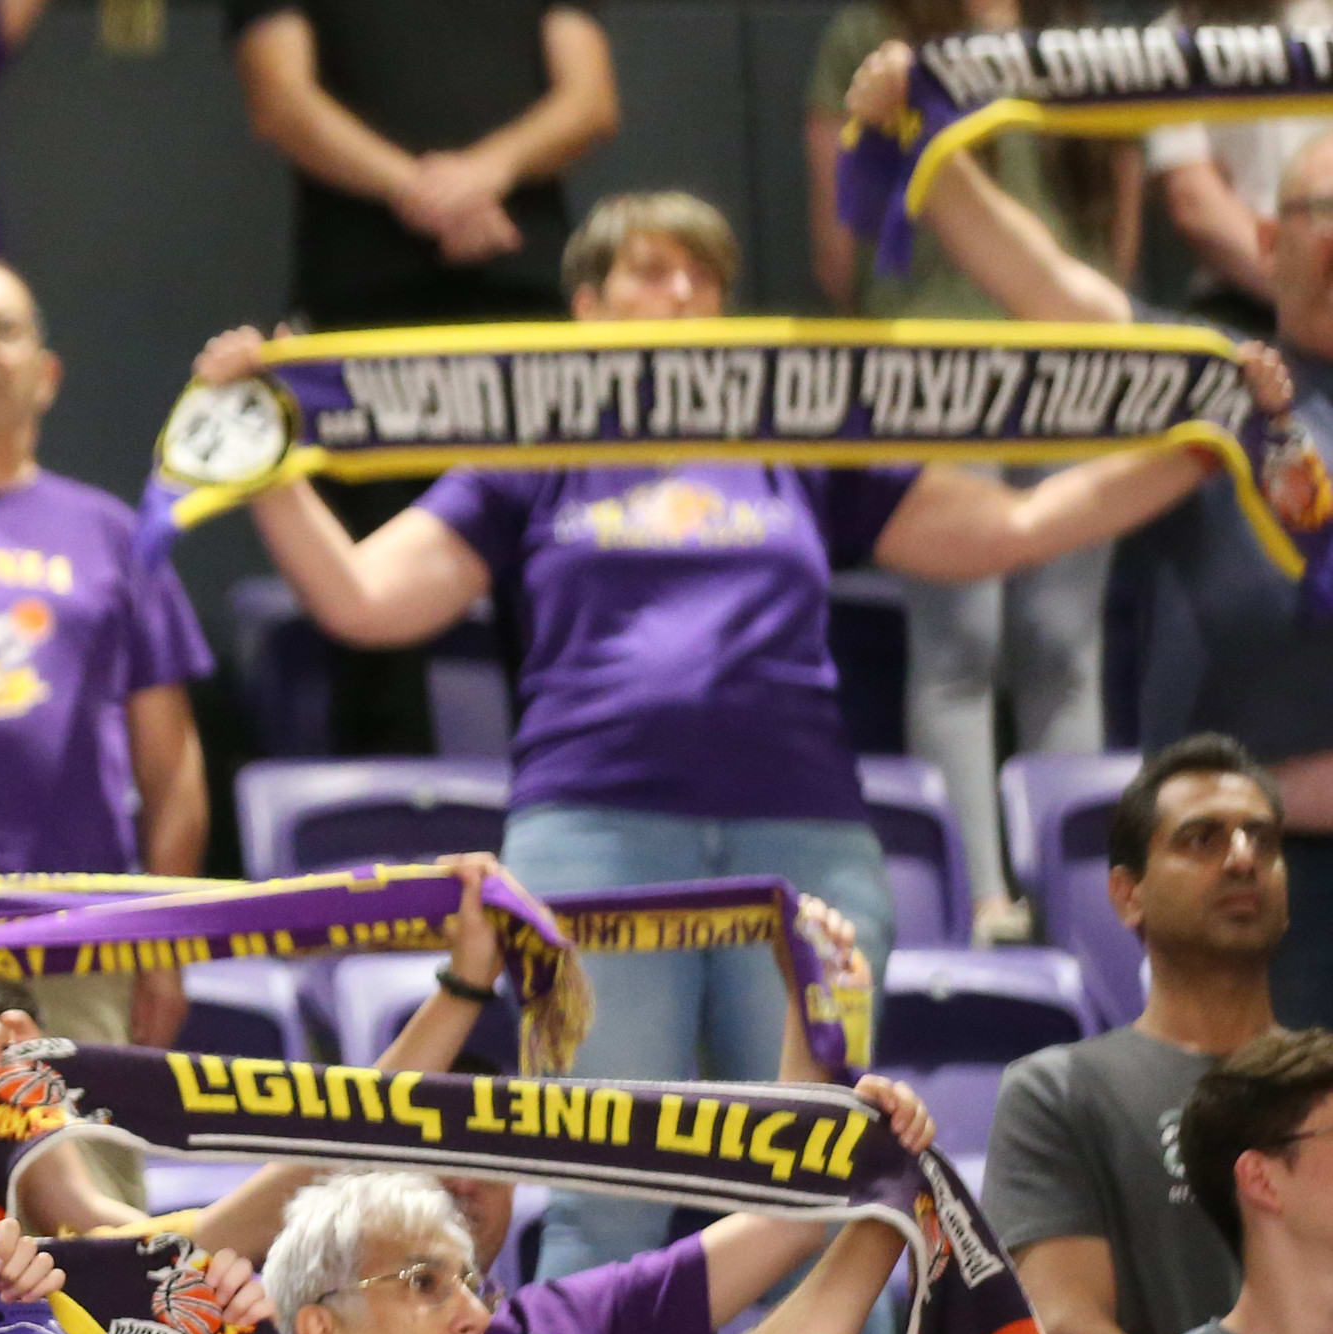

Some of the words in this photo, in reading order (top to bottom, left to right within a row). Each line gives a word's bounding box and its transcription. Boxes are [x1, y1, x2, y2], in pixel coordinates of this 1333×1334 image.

[1195, 25, 1288, 86] ON
[511, 352, 641, 445] דימיון
[648, 348, 765, 440] קצת
[772, 347, 850, 438] עם
[860, 348, 1026, 436] לעצמי
[1020, 350, 1188, 436] מרשה
[168, 1052, 444, 1142] הפועל
[466, 1076, 631, 1148] UNET
[656, 1093, 869, 1182] חולון
